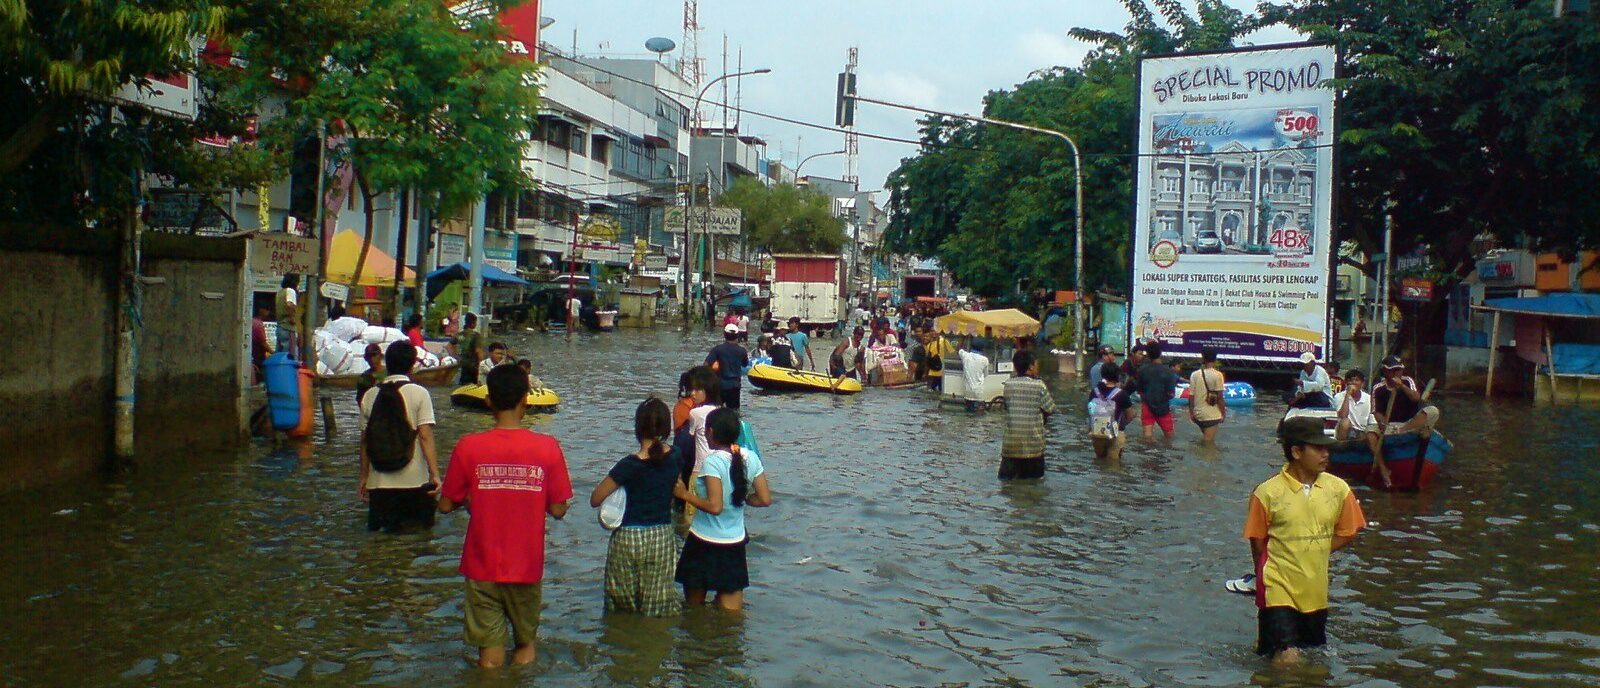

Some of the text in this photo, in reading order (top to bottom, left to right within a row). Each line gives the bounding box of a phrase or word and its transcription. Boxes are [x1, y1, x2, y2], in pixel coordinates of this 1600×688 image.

[1153, 61, 1321, 103] SPECIAL PROMO
[1182, 91, 1249, 103] Dibuka Lokasi Baru
[1283, 115, 1318, 132] 500
[1269, 229, 1308, 248] 48x
[262, 239, 310, 254] TAMBAL
[271, 250, 293, 262] BAN
[289, 263, 309, 273] JAM
[1142, 273, 1319, 284] LOKASI SUPER STRATEGIS, FASILITAS SUPER LENGKAP
[1187, 288, 1205, 296] Rumah
[1225, 289, 1241, 297] Dekat
[1241, 289, 1254, 297] Club
[1255, 290, 1271, 298] House
[1278, 290, 1306, 300] Swimming
[1306, 291, 1319, 299] Pool
[1160, 297, 1175, 305] Dekat
